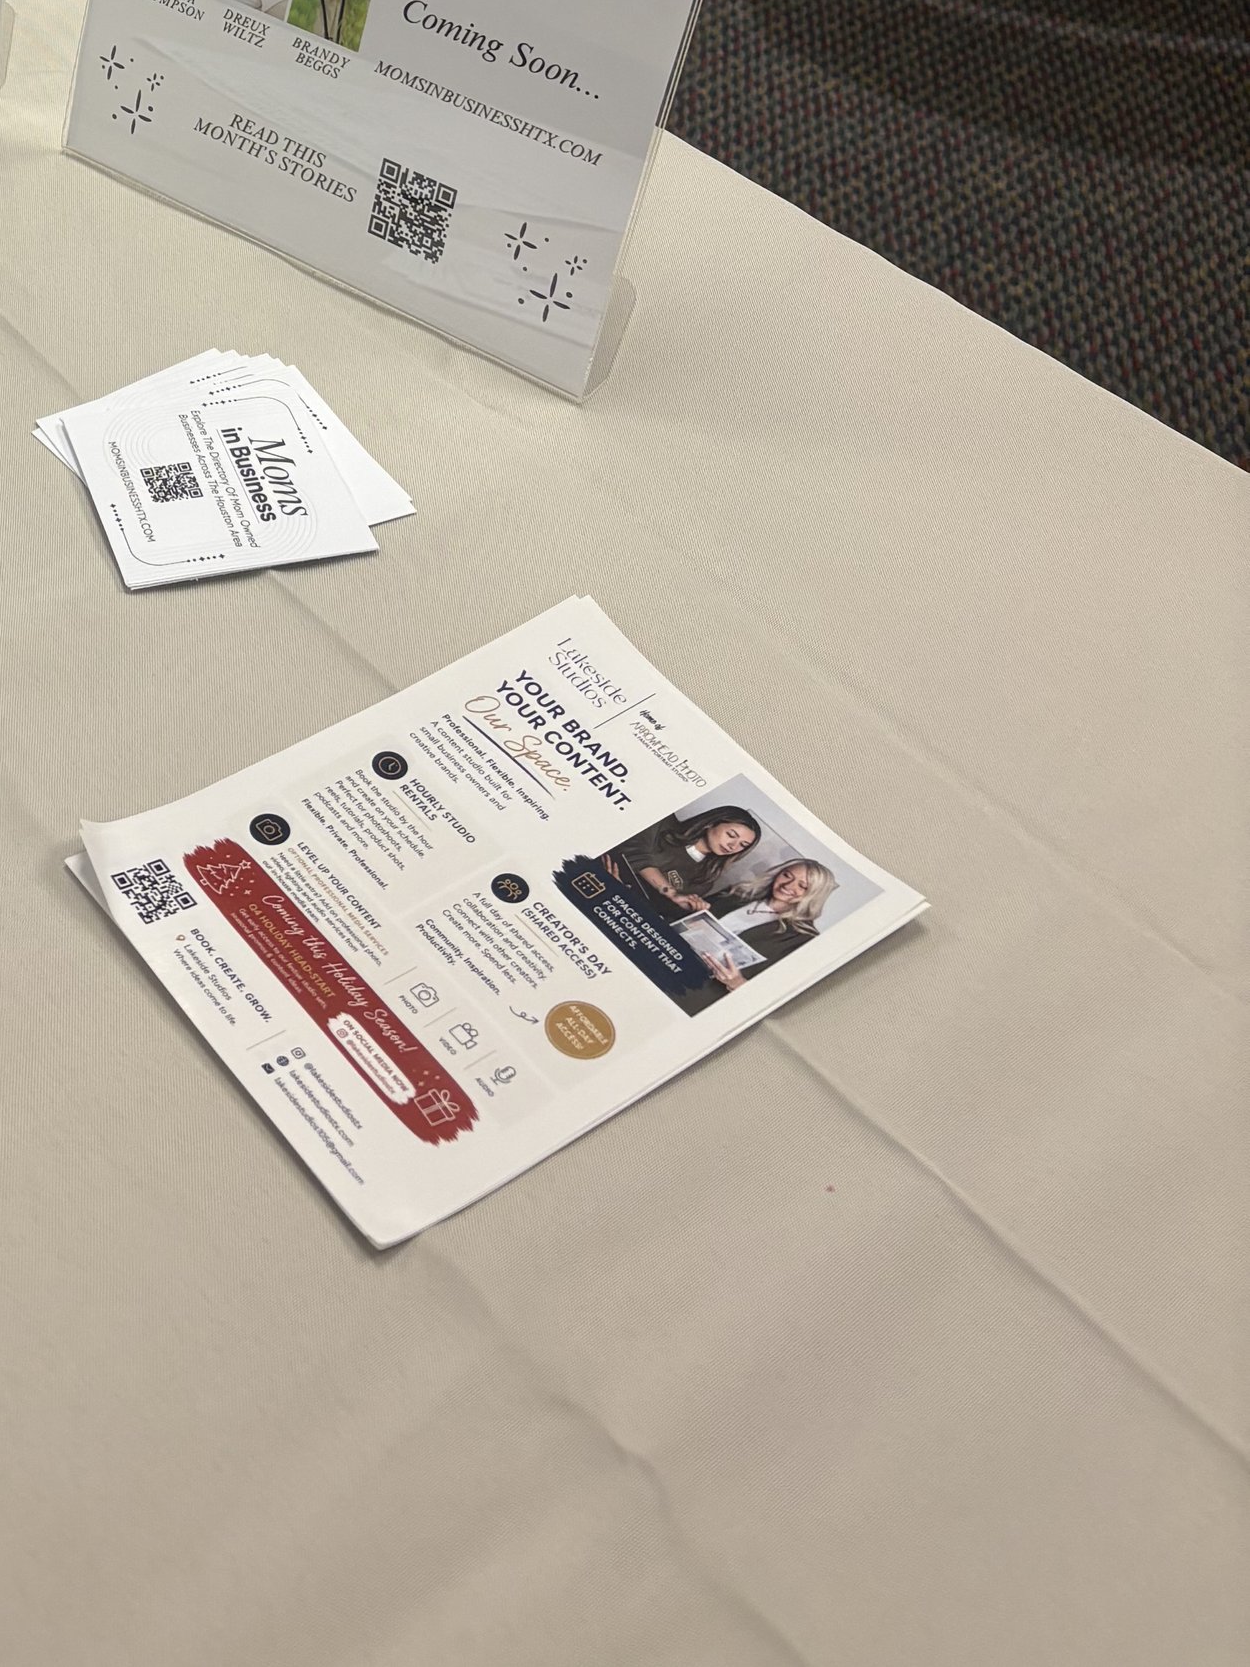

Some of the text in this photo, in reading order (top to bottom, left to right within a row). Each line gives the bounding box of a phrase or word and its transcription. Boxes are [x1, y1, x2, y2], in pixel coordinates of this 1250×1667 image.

[222, 8, 270, 36] DREUX
[222, 20, 265, 48] WILTZ
[291, 36, 351, 68] BRANDY
[403, 0, 599, 99] Coming Soon...
[294, 51, 341, 79] BEGGS
[228, 113, 327, 168] READ THIS
[373, 59, 603, 166] MOMSINBUSINESSHTX.COM
[193, 117, 357, 203] MONTH'S STORIES
[107, 441, 156, 543] MOMSINBUSINESSHTX.COM
[190, 409, 261, 548] Explore The Directory Of Mom Owned
[220, 426, 277, 522] in Business
[247, 436, 309, 516] Moms
[548, 651, 607, 708] Studios
[556, 637, 627, 704] Lakeside
[441, 713, 549, 821] Professional. Flexible. Inspiring.
[464, 695, 571, 792] Our Space.
[496, 679, 632, 811] YOUR CONTENT.
[515, 669, 628, 783] YOUR BRAND.
[399, 783, 438, 821] RENTALS
[409, 778, 476, 843] HOURLY STUDIO
[189, 928, 272, 1023] BOOK. CREATE. GROW.
[532, 901, 612, 974] CREATOR'S DAY
